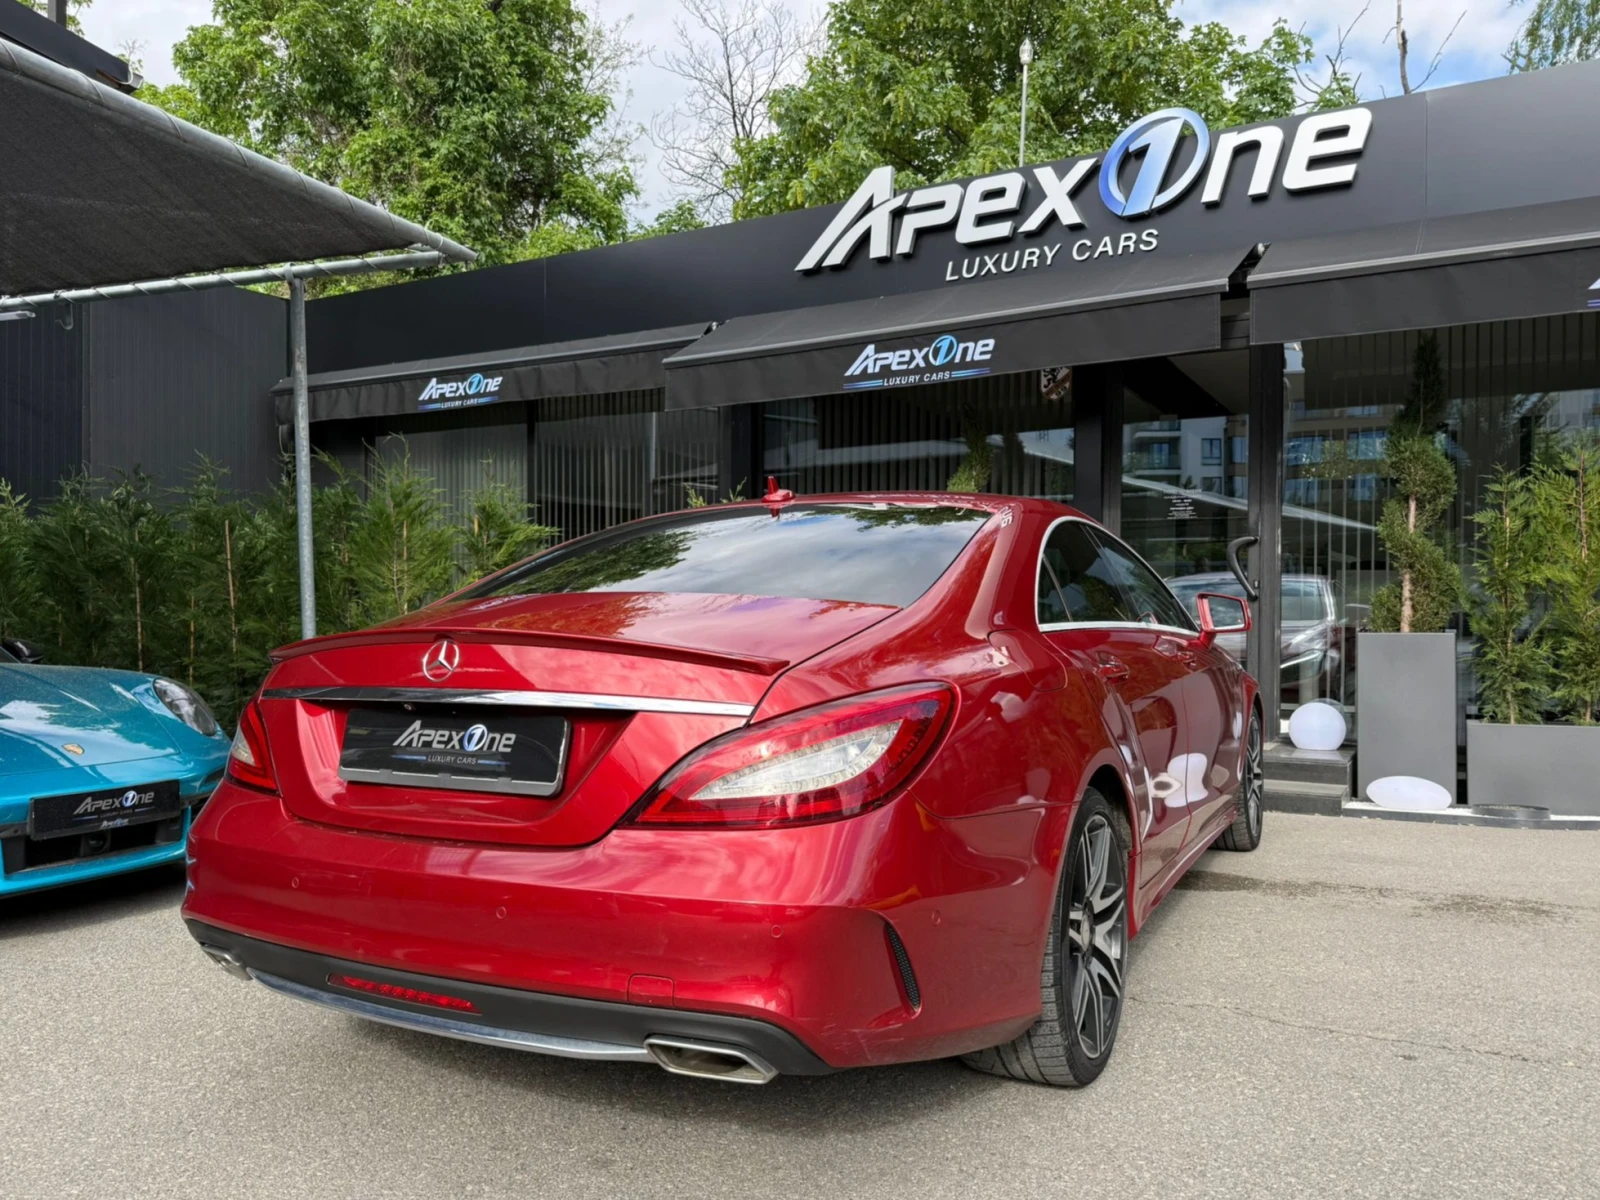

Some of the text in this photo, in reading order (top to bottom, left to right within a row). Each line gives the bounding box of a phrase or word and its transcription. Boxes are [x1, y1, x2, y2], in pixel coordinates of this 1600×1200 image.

[945, 229, 1159, 281] LUXURY CARS
[884, 371, 950, 386] LUXURY CARS
[441, 400, 462, 408] LUXURY
[427, 754, 477, 765] LUXURY CARS
